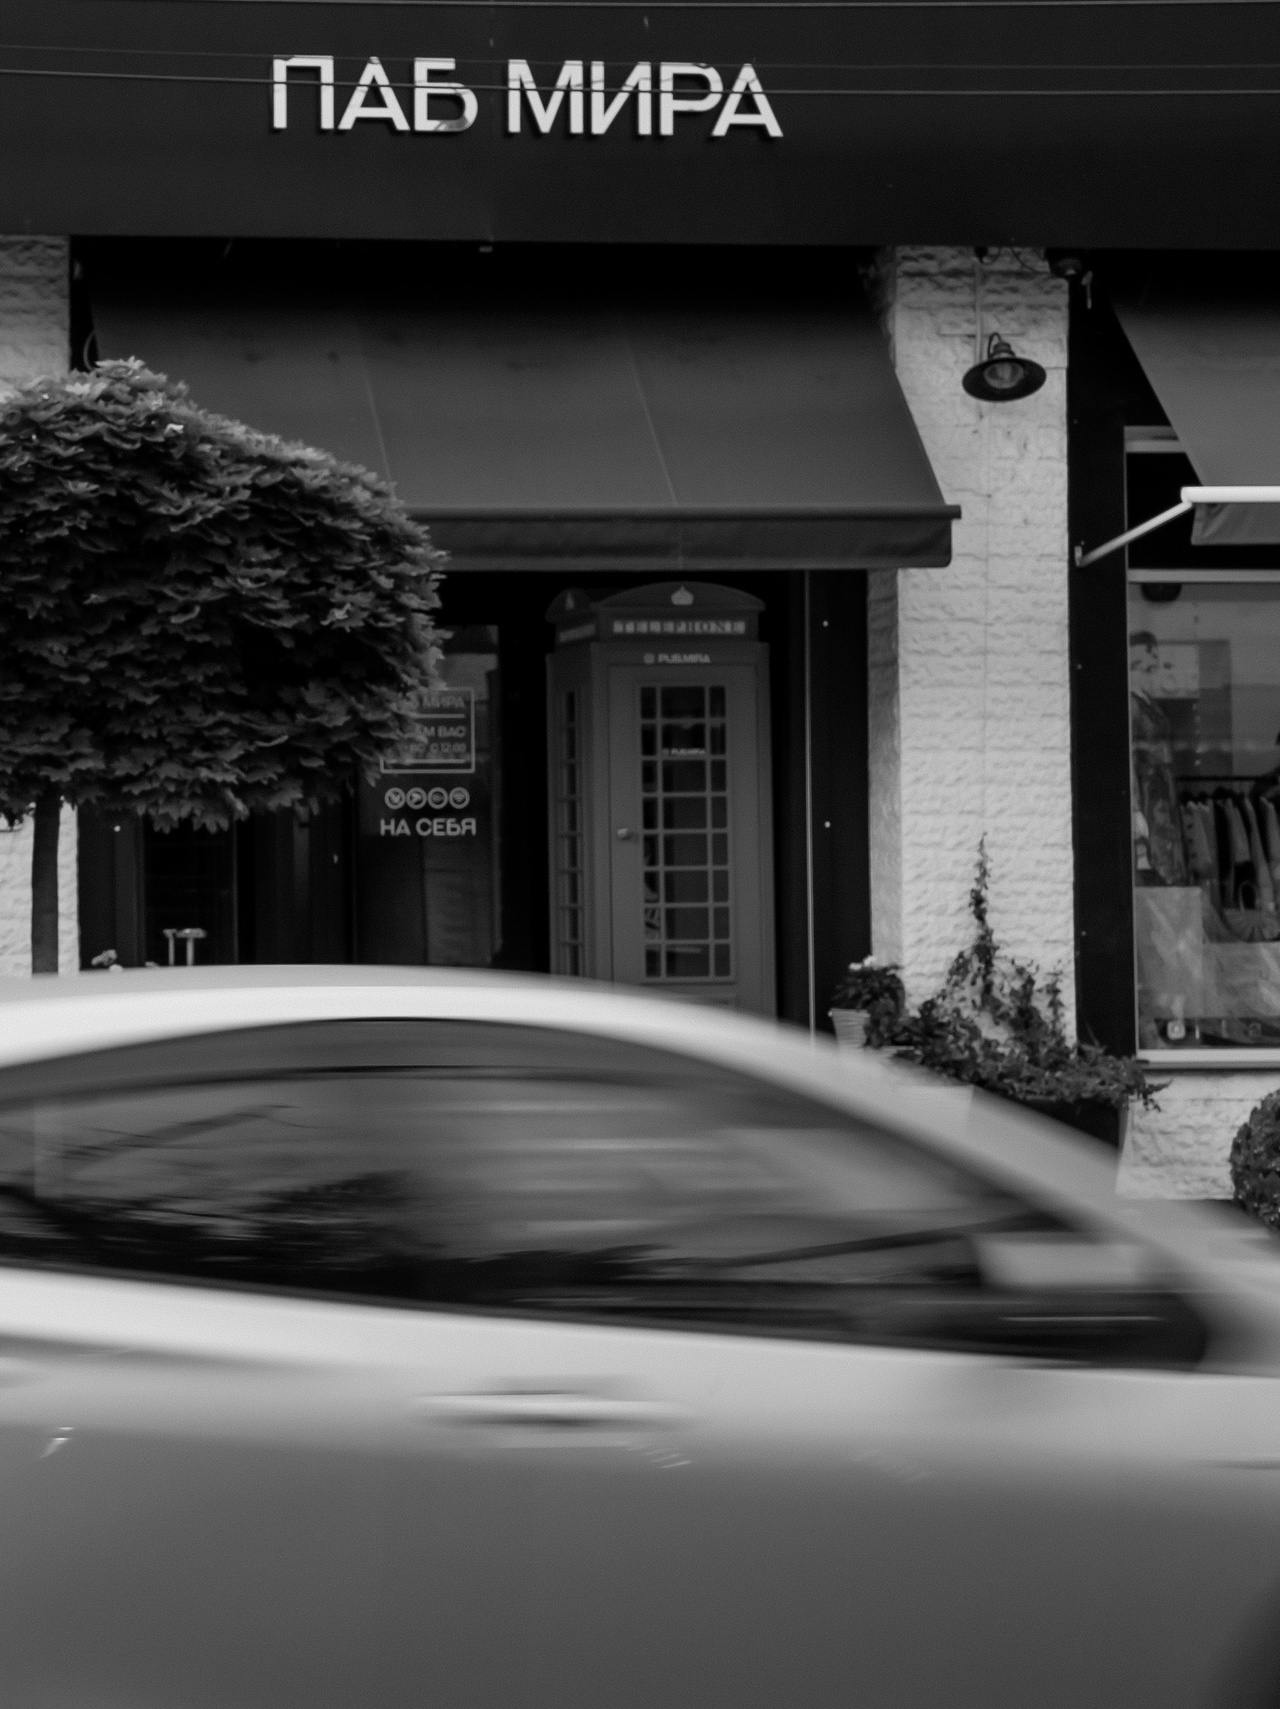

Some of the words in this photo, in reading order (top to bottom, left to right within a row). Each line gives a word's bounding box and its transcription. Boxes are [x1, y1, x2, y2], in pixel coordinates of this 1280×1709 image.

[271, 54, 479, 133] ПАБ
[506, 58, 784, 138] МИРА
[612, 619, 746, 635] TELEPHONE
[379, 818, 412, 837] НА
[415, 817, 477, 837] СЕБЯ
